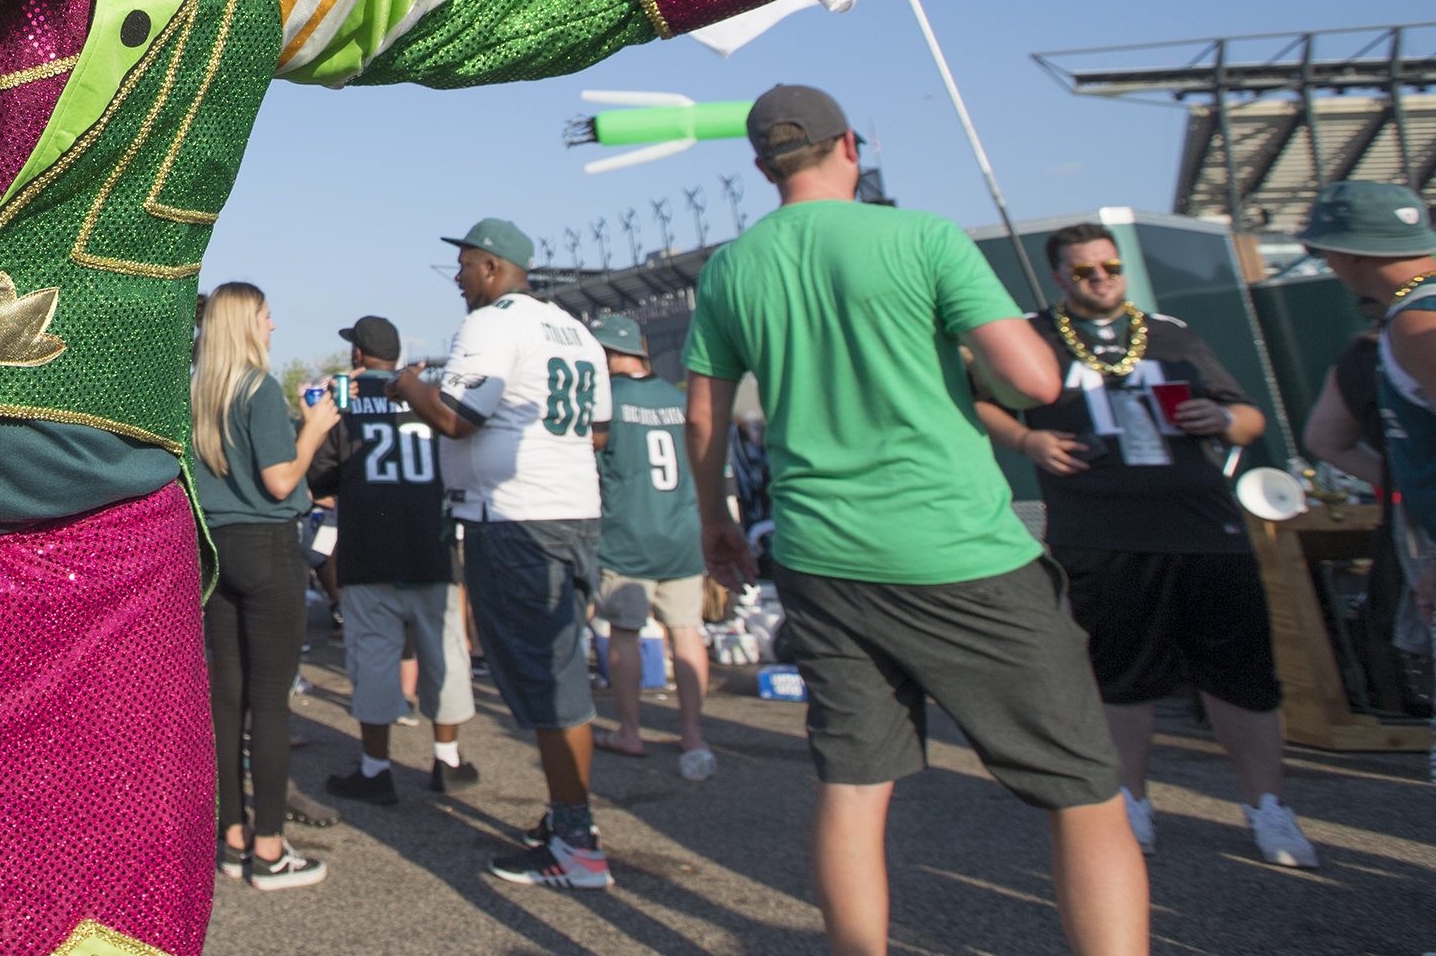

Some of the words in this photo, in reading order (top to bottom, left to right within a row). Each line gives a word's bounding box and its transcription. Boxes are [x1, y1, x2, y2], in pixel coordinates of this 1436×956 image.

[543, 357, 595, 437] 88
[363, 422, 435, 483] 20
[646, 429, 679, 492] 9
